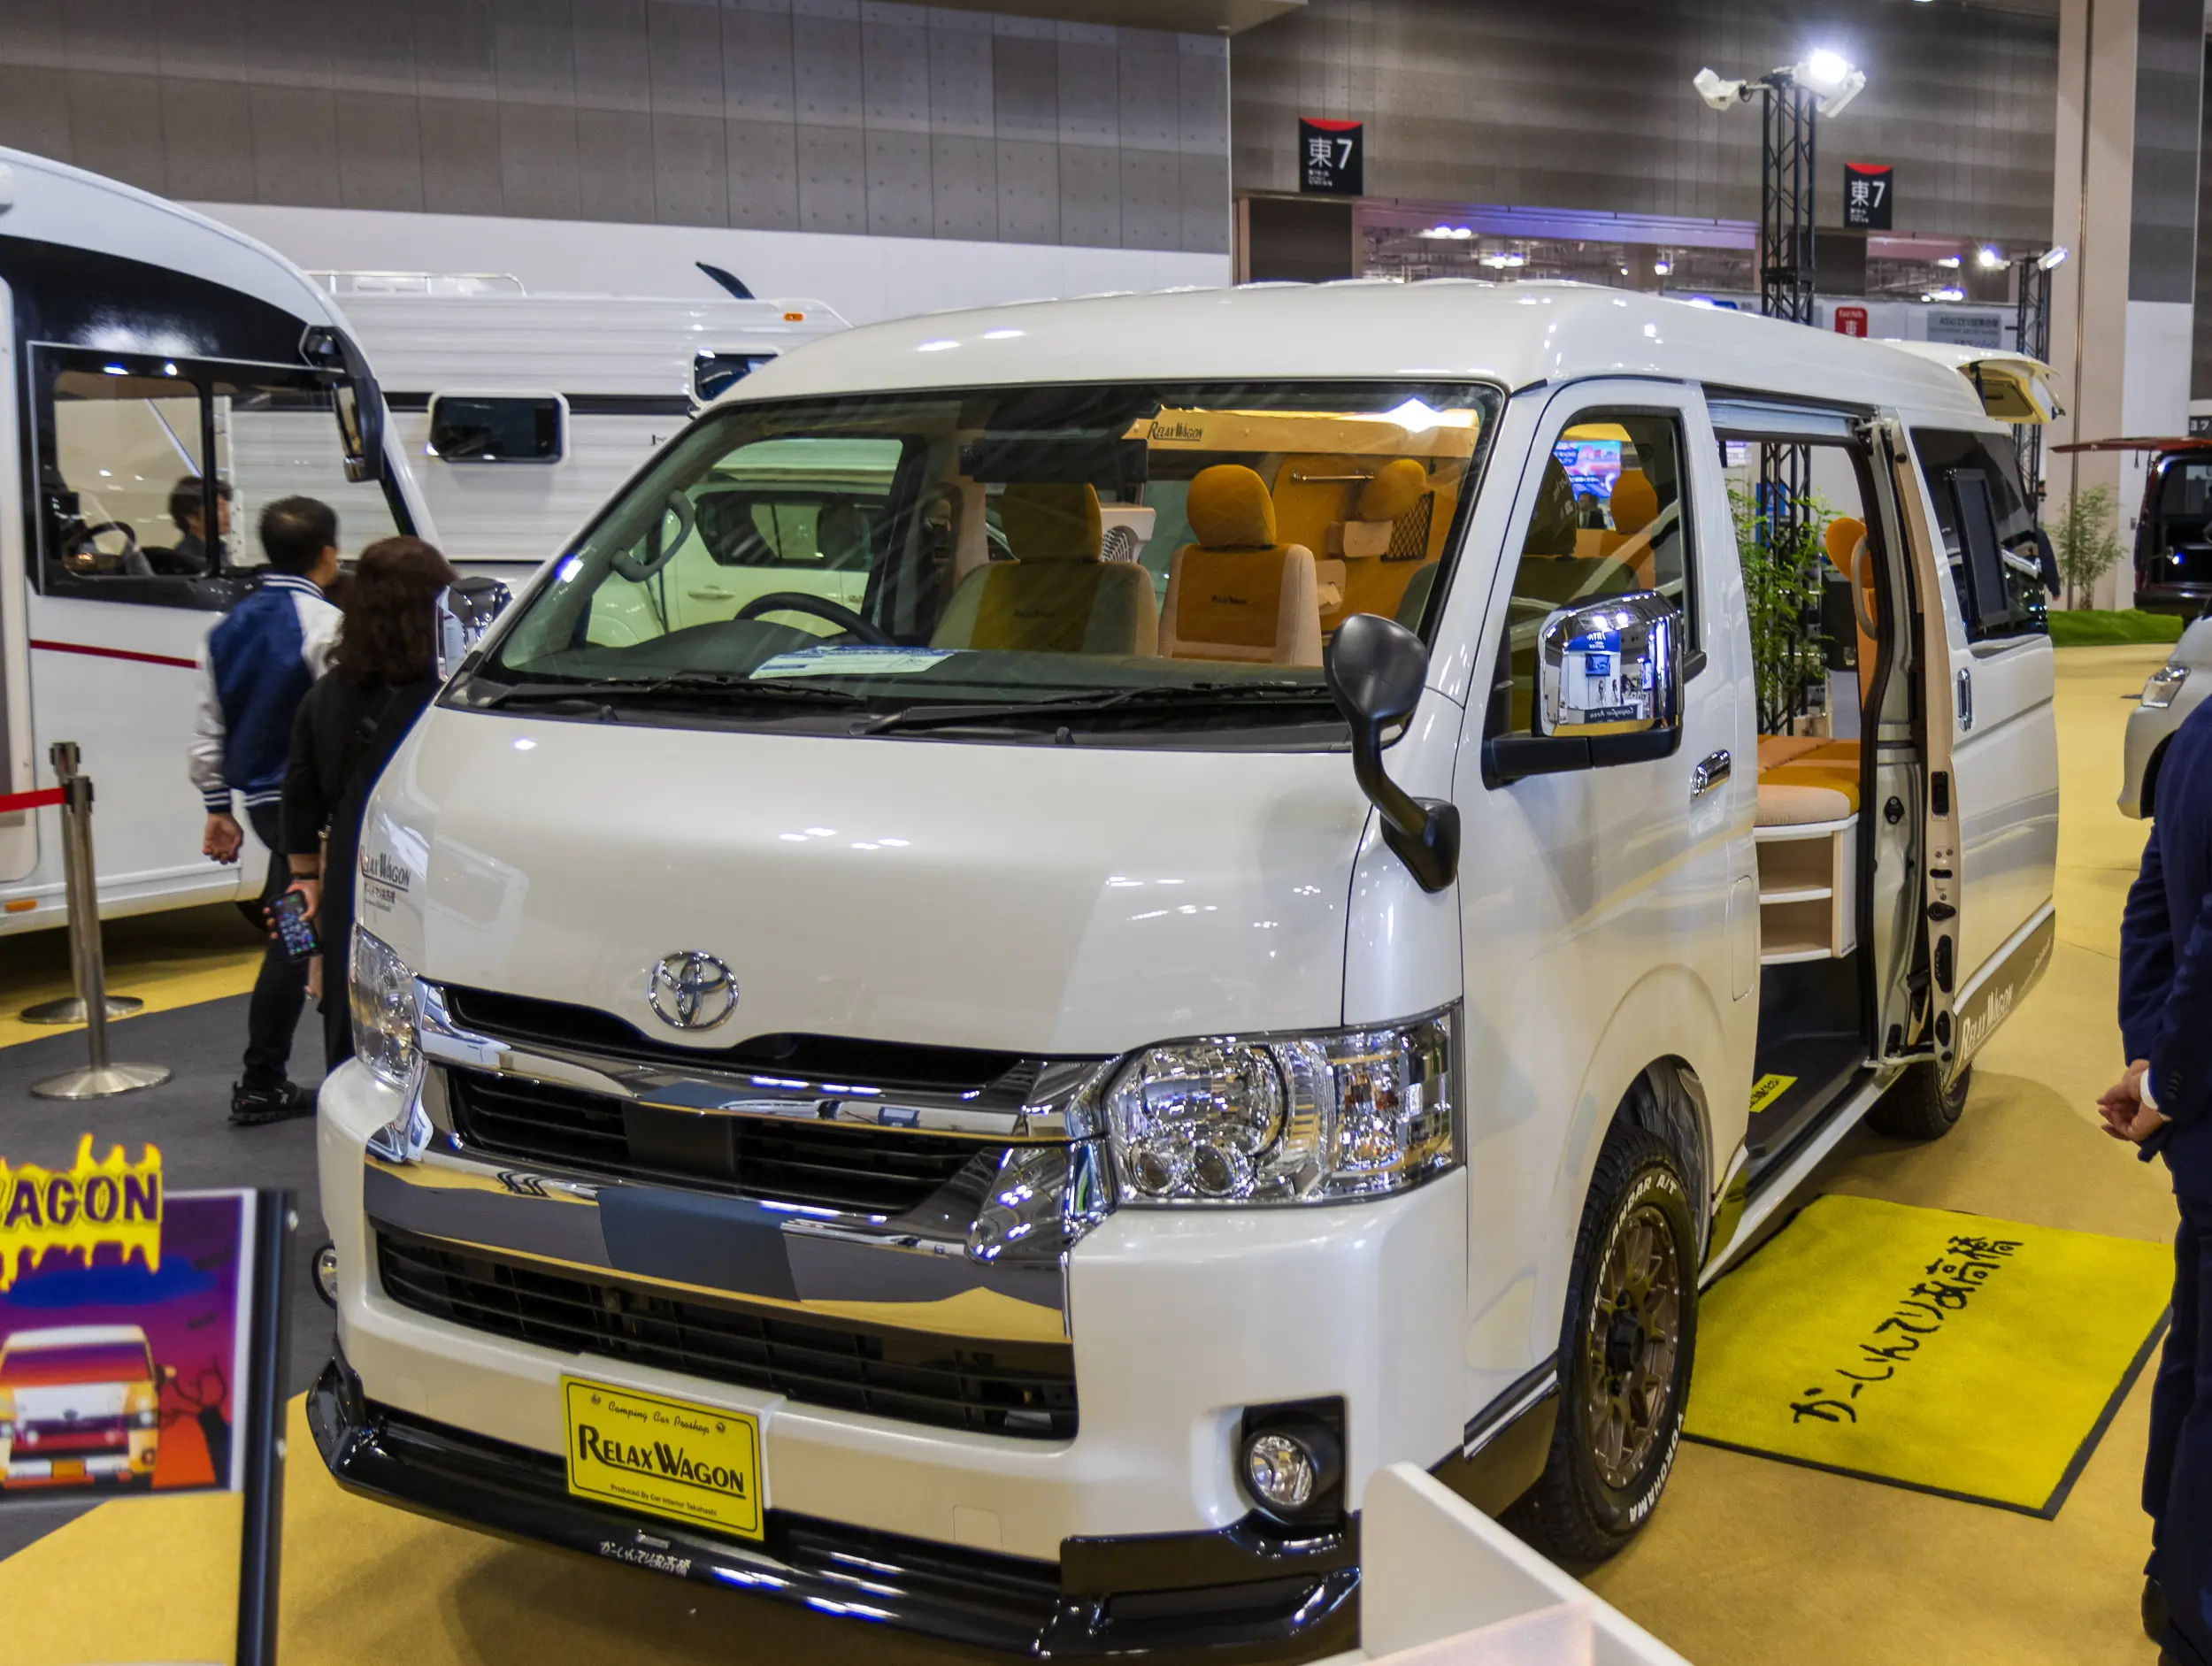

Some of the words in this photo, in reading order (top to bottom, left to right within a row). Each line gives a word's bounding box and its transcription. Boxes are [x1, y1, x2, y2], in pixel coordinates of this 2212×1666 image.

[1309, 136, 1353, 169] 東7
[1851, 180, 1886, 208] 東7
[0, 1172, 157, 1228] AGON
[1656, 1174, 1678, 1195] A/T
[608, 1401, 648, 1423] Camping
[653, 1410, 670, 1424] Car
[673, 1416, 710, 1437] Proshop
[1629, 1411, 1684, 1523] YOKOHAMA
[611, 1483, 640, 1497] Produced
[641, 1491, 649, 1501] By
[663, 1496, 686, 1509] Interior
[686, 1502, 718, 1516] Takahashi
